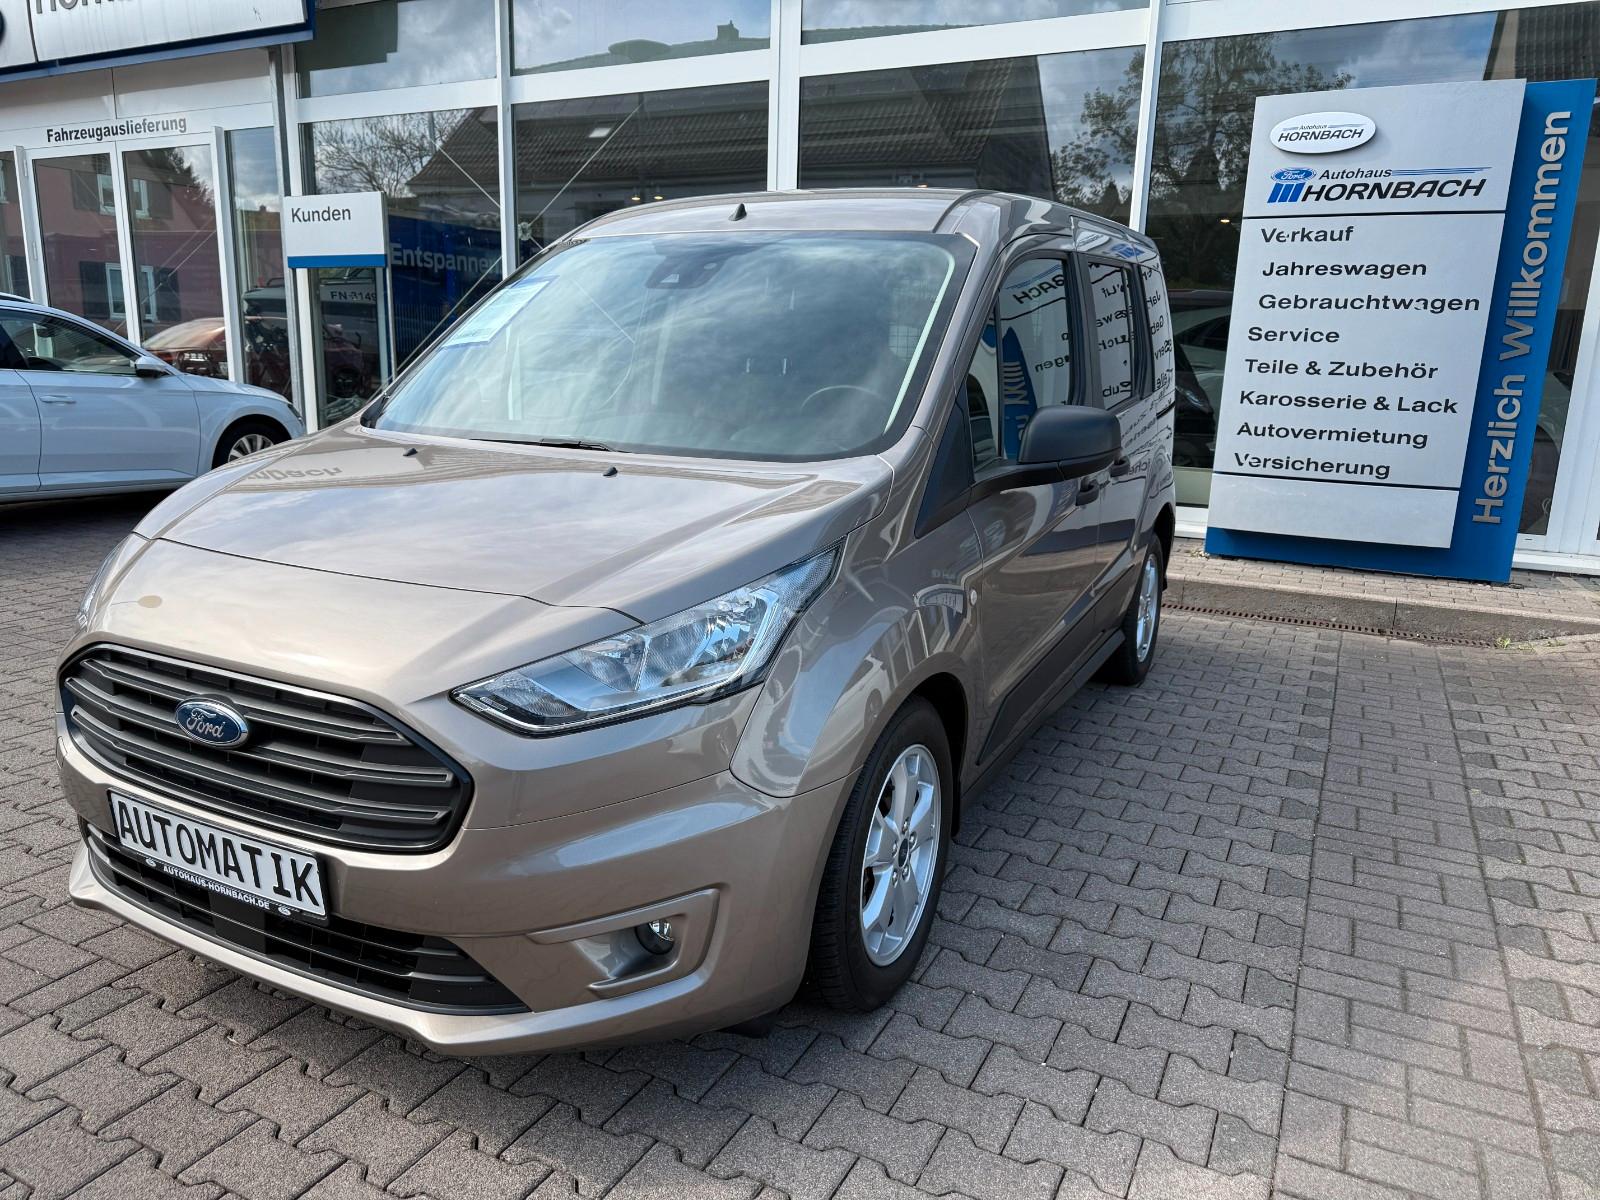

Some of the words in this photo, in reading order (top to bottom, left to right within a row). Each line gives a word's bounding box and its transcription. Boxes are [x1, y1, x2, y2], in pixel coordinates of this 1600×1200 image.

[46, 117, 187, 143] Fahrzeugauslieferung
[1278, 129, 1364, 142] HORNBACH
[1319, 168, 1392, 180] Autohaus
[1301, 178, 1488, 202] HORNBACH
[291, 206, 352, 223] Kunden
[1261, 226, 1355, 243] Verkauf
[1262, 261, 1427, 279] Jahreswagen
[1259, 294, 1481, 314] Gebrauchtwagen
[1472, 374, 1526, 524] Herzlich
[1499, 110, 1572, 361] Willkommen
[1248, 327, 1340, 343] Service
[1245, 359, 1299, 376] Teile
[1305, 360, 1322, 376] &
[1328, 361, 1439, 379] Zubehör
[1239, 390, 1367, 410] Karosserie
[1373, 396, 1390, 411] &
[1397, 396, 1459, 414] Lack
[1237, 422, 1429, 449] Autovermietung
[1234, 453, 1391, 479] Versicherung
[186, 706, 227, 739] Ford
[117, 800, 320, 907] AUTOMATIK
[163, 865, 271, 910] AUTOHAUS-HORNBACH.DE
